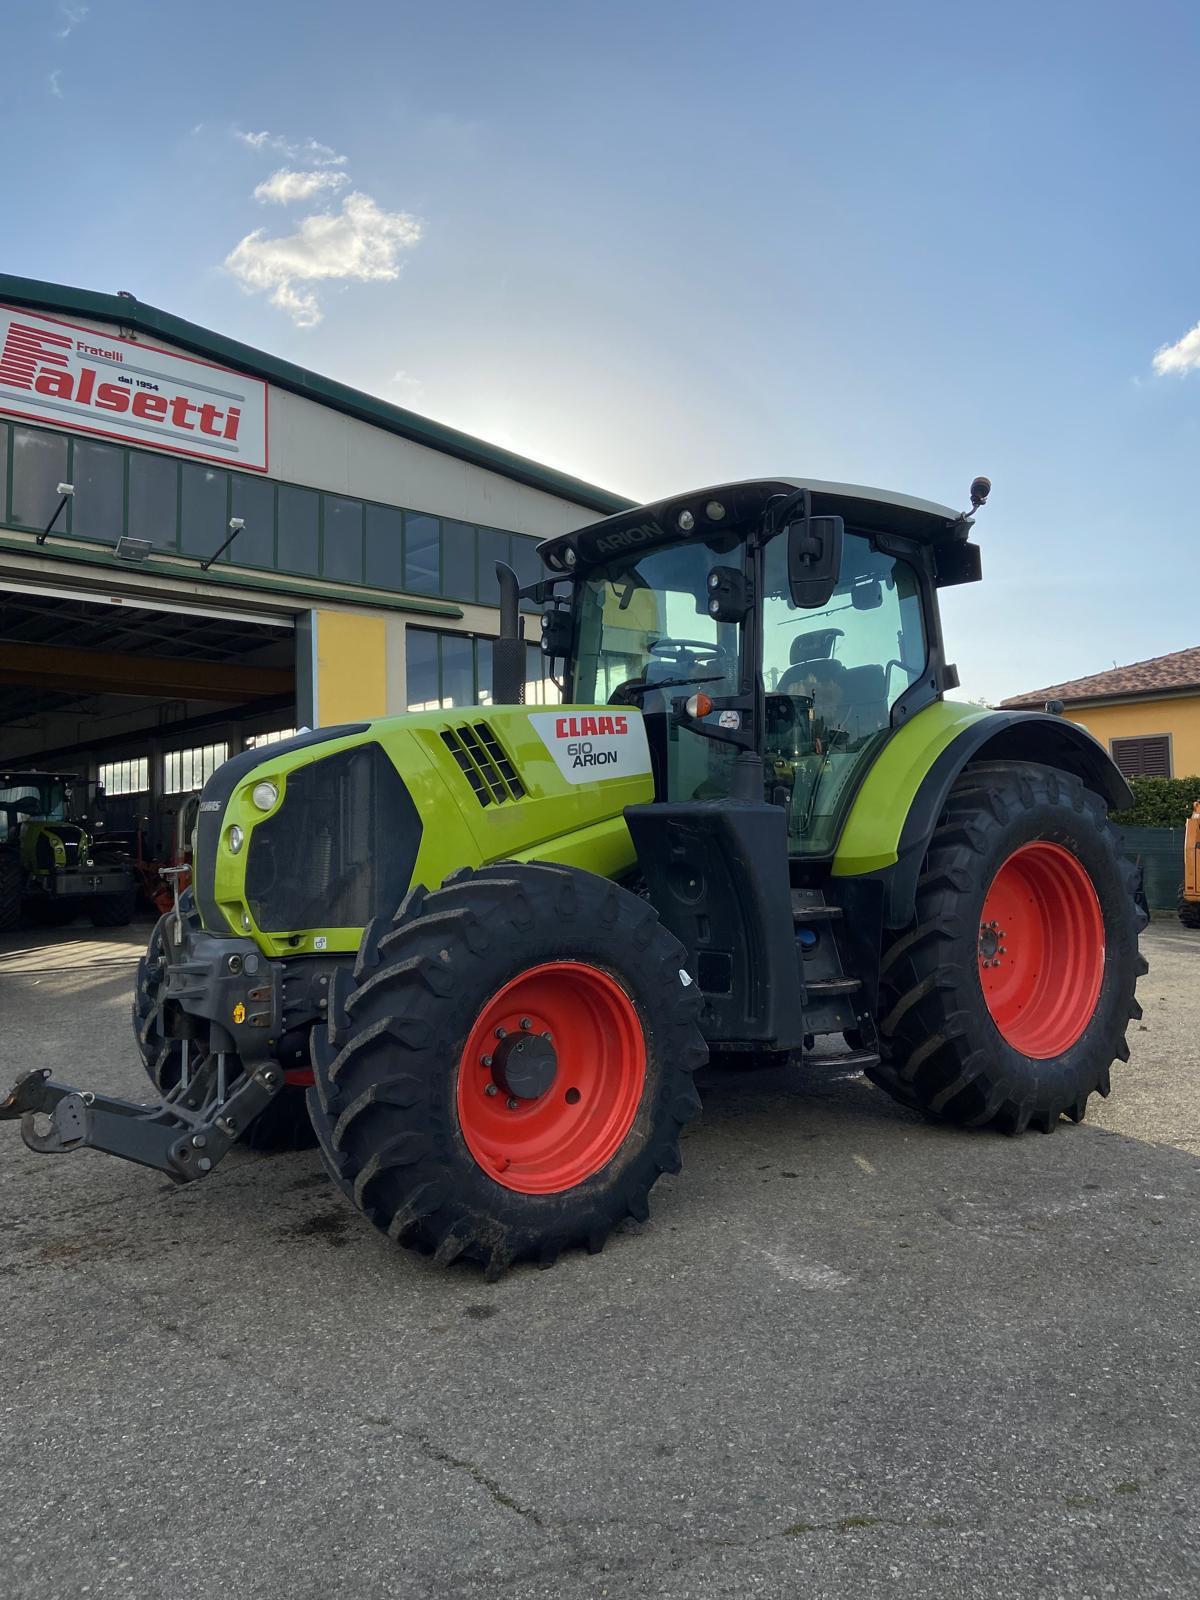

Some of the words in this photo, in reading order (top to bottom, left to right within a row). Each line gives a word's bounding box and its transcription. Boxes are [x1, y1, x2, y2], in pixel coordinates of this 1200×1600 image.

[76, 341, 124, 363] Fratelli
[118, 375, 133, 386] dal
[135, 379, 159, 392] 1954
[596, 522, 664, 552] ARION
[556, 716, 628, 738] CLAAS
[567, 742, 593, 756] 610
[572, 751, 618, 768] ARION
